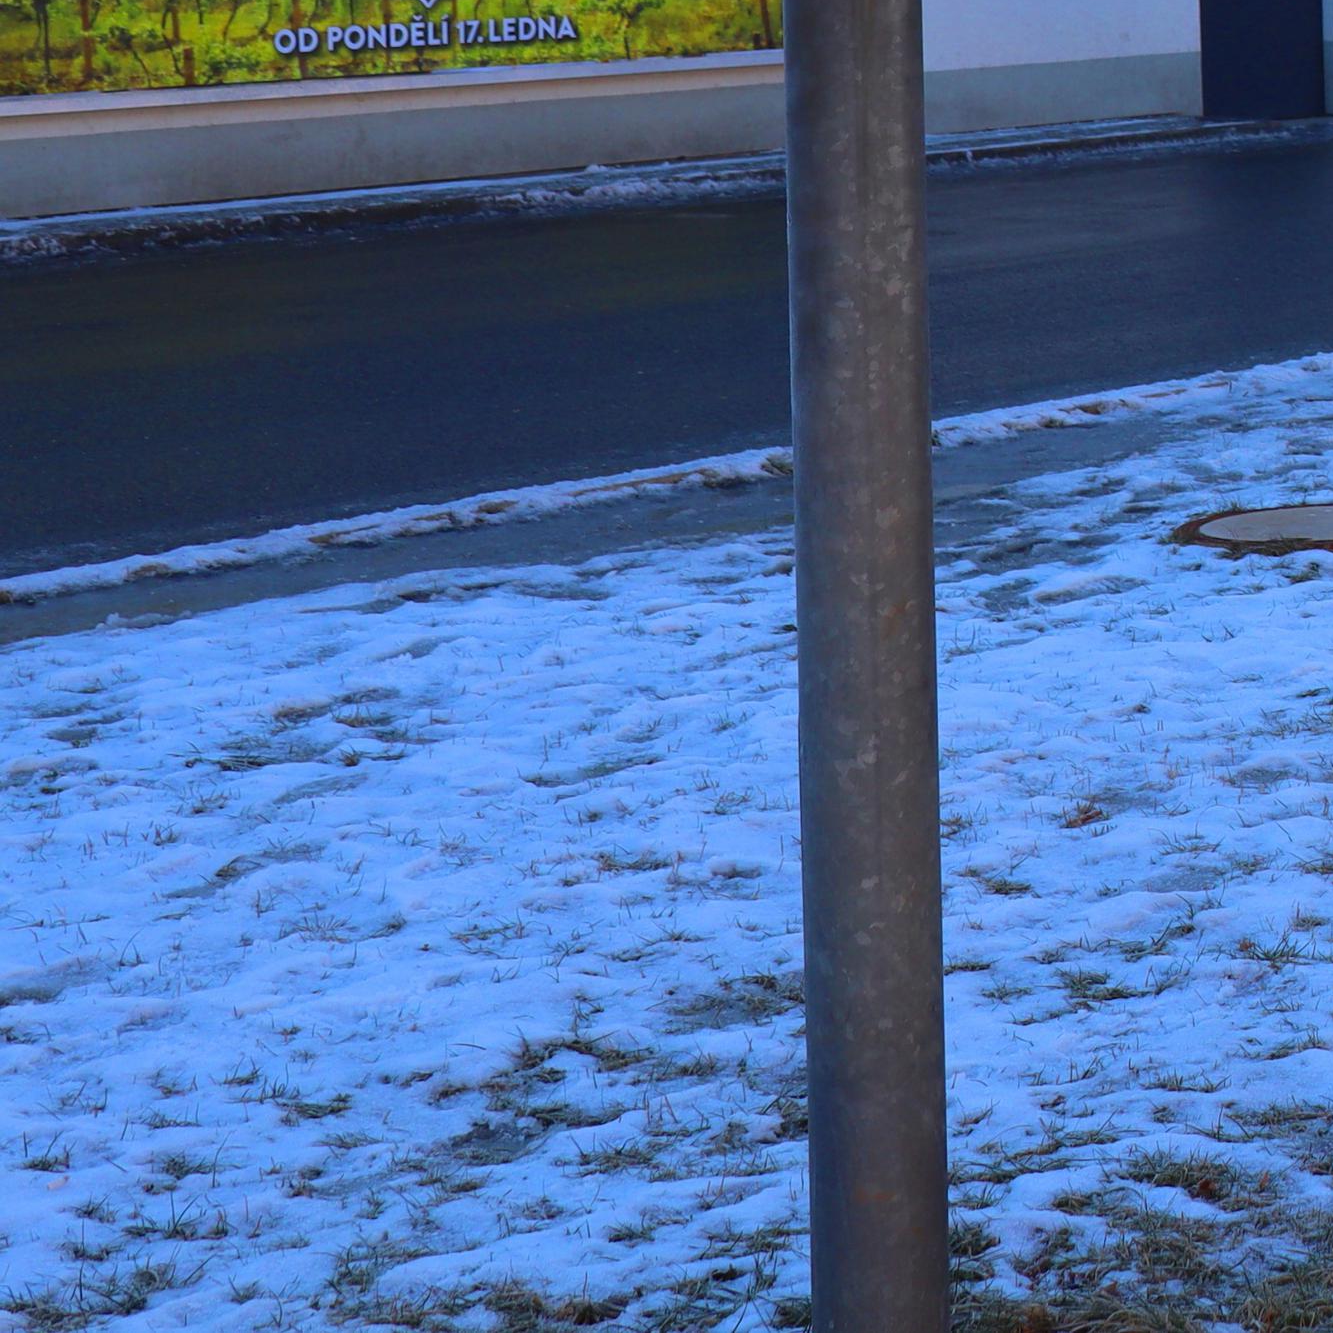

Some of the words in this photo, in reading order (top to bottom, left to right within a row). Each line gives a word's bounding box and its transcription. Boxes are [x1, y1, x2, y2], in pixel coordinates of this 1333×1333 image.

[274, 27, 318, 54] OD
[326, 14, 449, 51] PONDĚLÍ
[456, 20, 483, 44] 17.
[488, 16, 576, 42] LEDNA
